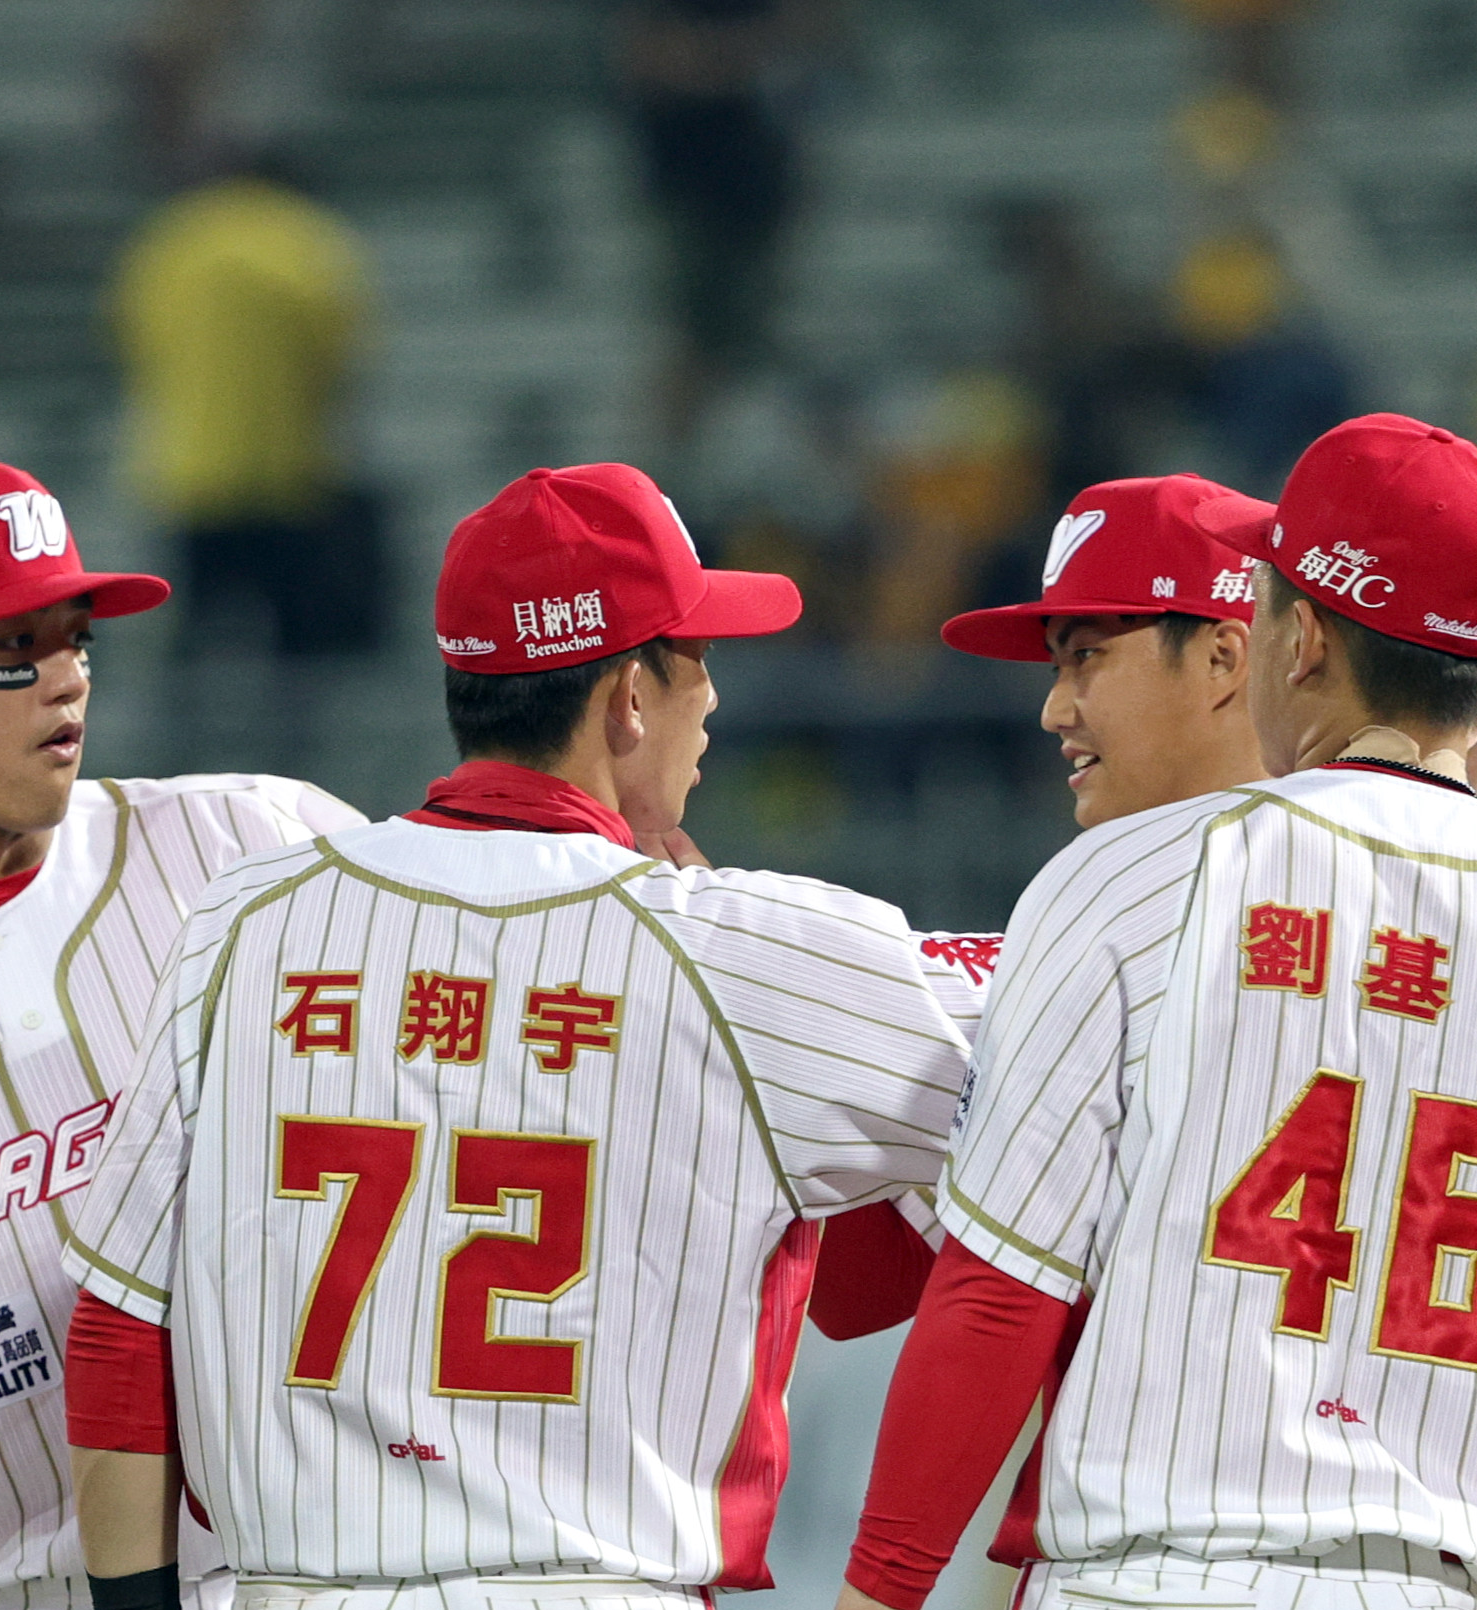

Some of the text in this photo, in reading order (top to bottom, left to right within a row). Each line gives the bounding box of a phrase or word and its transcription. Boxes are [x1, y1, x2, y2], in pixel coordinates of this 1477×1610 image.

[1295, 545, 1396, 609] 每日C
[513, 588, 607, 643] 貝納頌
[525, 634, 603, 659] Bernachon
[274, 969, 624, 1075] 石翔宇
[275, 1113, 599, 1404] 72
[388, 1432, 446, 1462] CPBL
